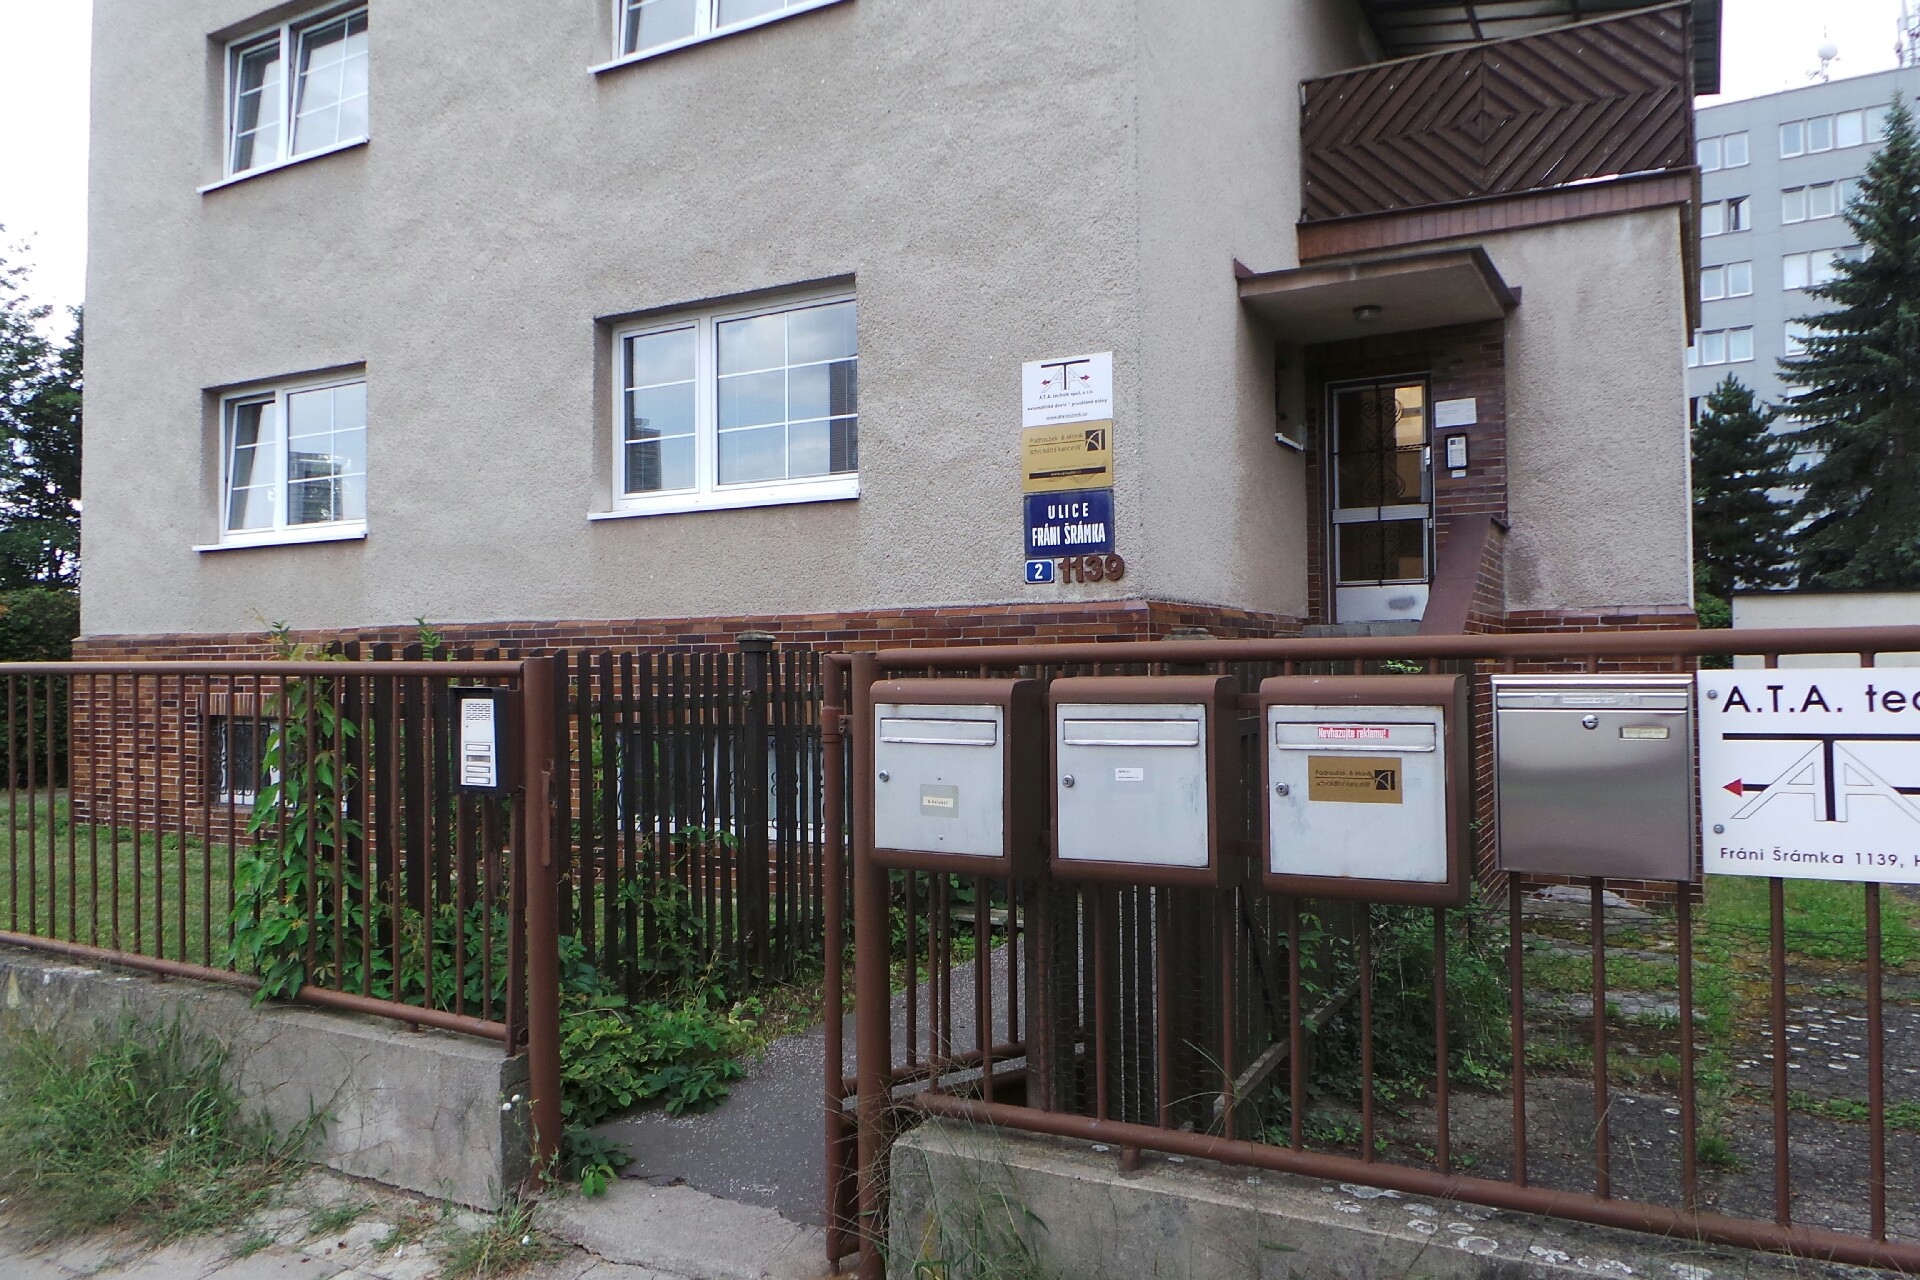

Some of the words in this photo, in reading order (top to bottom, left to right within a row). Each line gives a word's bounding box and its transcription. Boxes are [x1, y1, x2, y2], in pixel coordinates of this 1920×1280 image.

[1047, 502, 1089, 520] ULICE
[1032, 523, 1061, 547] FRÁNI
[1064, 520, 1106, 545] ŠRÁMKA
[1034, 563, 1044, 580] 2
[1058, 553, 1125, 584] 1139
[1721, 684, 1843, 713] A.T.A.
[1318, 727, 1355, 739] Nevhazujte
[1356, 728, 1386, 739] reklamu!
[1720, 847, 1764, 861] Fráni
[1773, 846, 1844, 864] Šrámka
[1855, 852, 1904, 869] 1139,
